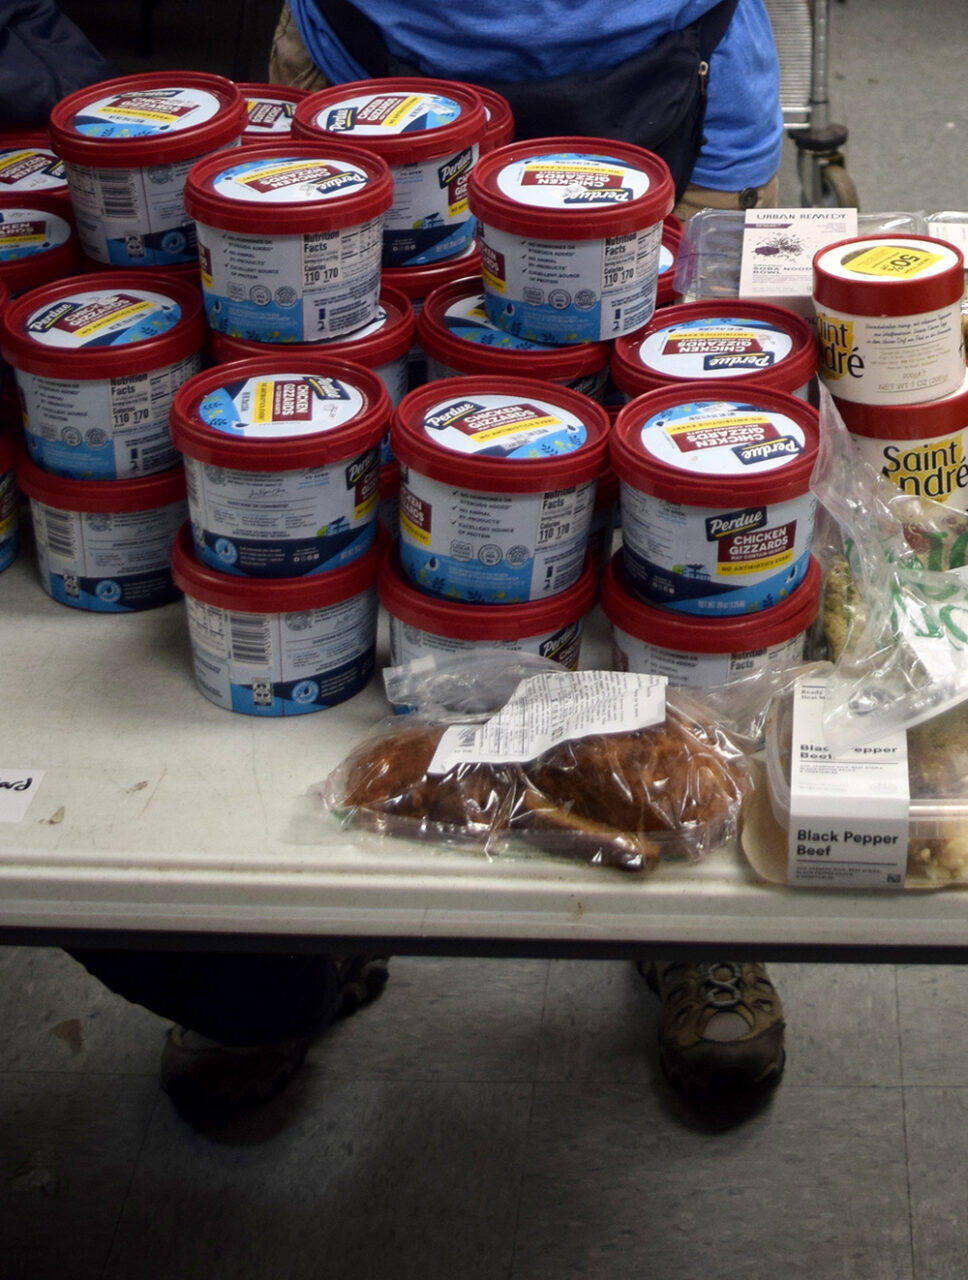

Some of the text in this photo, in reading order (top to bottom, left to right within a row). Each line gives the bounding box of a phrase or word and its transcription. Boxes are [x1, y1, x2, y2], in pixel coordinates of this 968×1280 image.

[319, 172, 366, 191] Perdue
[303, 229, 340, 243] Nutrition
[604, 232, 637, 246] Nutrition
[303, 241, 328, 253] Facts
[604, 245, 627, 257] Facts
[304, 267, 339, 283] 110 170
[604, 268, 635, 284] 110 170
[28, 303, 72, 331] Perdue
[69, 299, 131, 326] GIZZARDS
[677, 340, 753, 348] GIZZARDS
[678, 345, 746, 353] CHICKEN
[709, 355, 771, 367] Perdue
[824, 346, 866, 379] dré
[110, 373, 148, 386] Nutrition
[111, 384, 136, 396] Facts
[113, 409, 149, 424] 110 170
[426, 402, 475, 427] Perdue
[463, 406, 523, 424] CHICKEN
[468, 409, 536, 429] GIZZARDS
[686, 427, 765, 442] GIZZARDS
[695, 433, 765, 448] CHICKEN
[740, 440, 800, 460] Perdue
[883, 441, 958, 473] Saint
[542, 496, 564, 510] Facts
[710, 510, 763, 535] Perdue
[539, 528, 553, 540] 110
[733, 526, 787, 546] CHICKEN
[728, 535, 789, 556] GIZZARDS
[730, 659, 755, 671] Facts
[800, 744, 830, 752] Blac
[797, 829, 899, 846] Black Pepper
[796, 844, 832, 856] Beef
